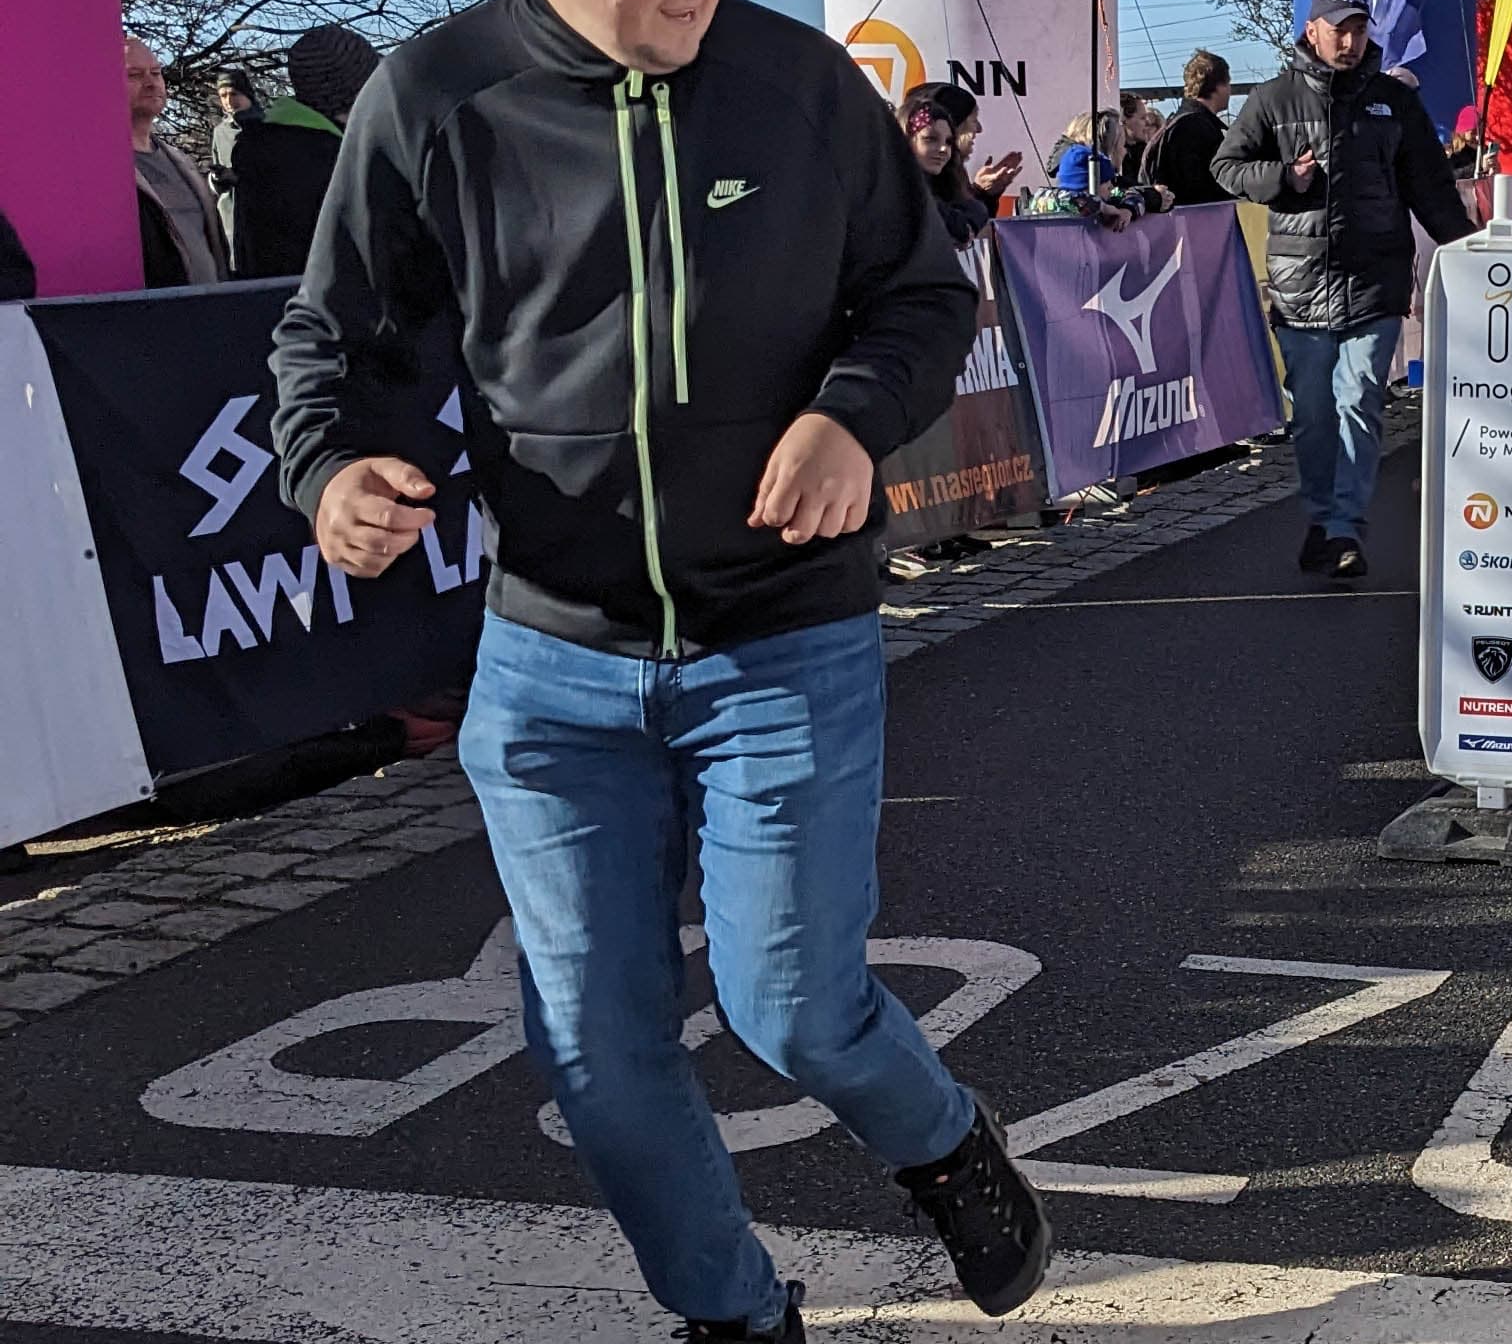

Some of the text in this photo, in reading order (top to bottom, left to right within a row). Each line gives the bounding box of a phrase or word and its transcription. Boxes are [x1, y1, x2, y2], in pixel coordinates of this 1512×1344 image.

[946, 60, 1027, 97] NN
[714, 180, 746, 196] NIKE
[1480, 443, 1497, 458] by
